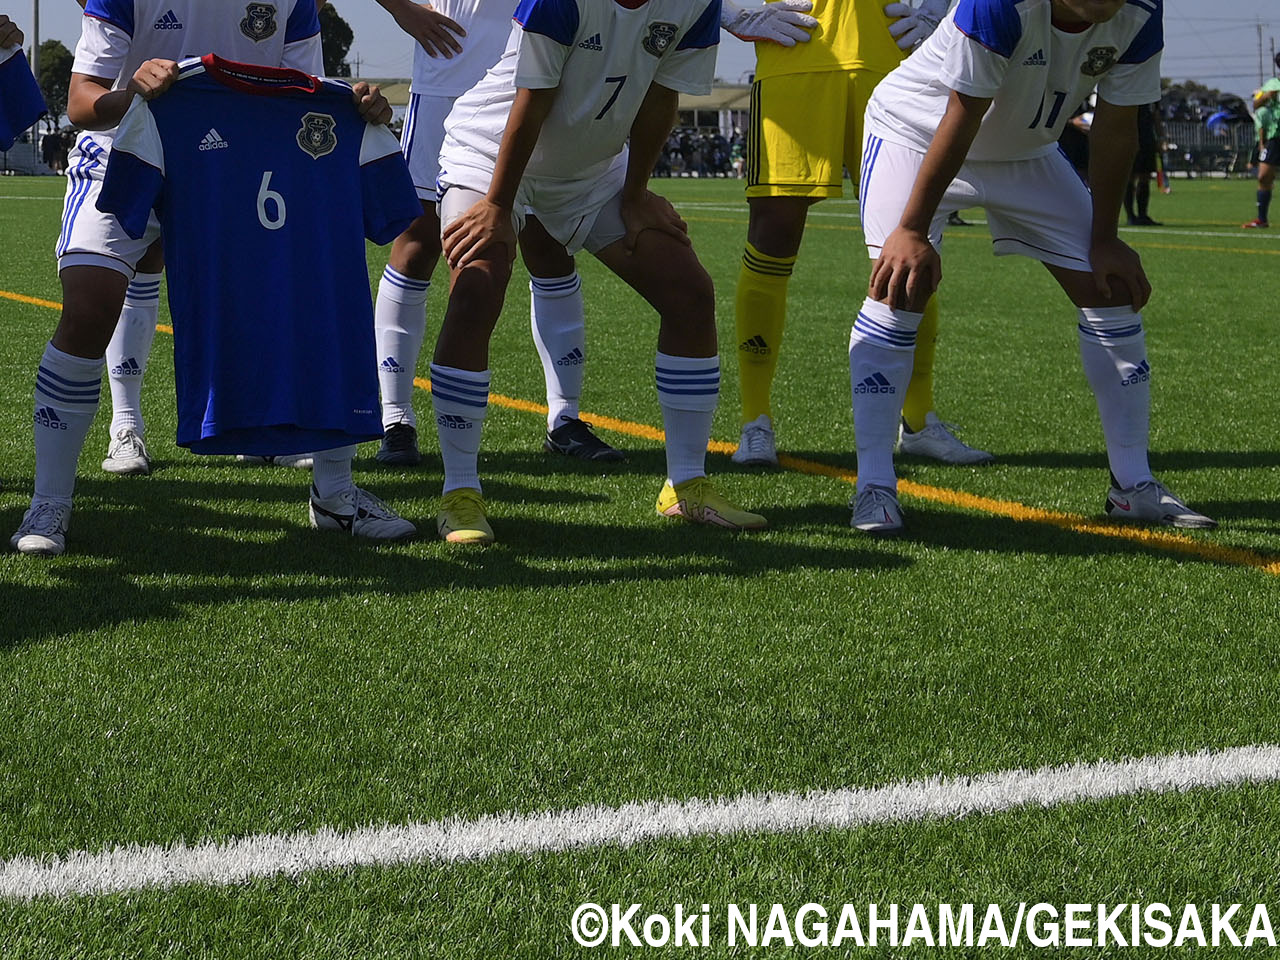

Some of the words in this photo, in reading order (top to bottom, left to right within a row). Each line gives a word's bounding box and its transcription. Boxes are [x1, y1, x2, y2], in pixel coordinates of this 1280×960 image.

[154, 22, 183, 30] adidas
[578, 42, 603, 51] adidas
[594, 75, 627, 121] 7
[1028, 88, 1067, 129] 11
[198, 141, 229, 151] adidas
[256, 171, 286, 230] 6
[112, 368, 142, 376] adidas
[854, 385, 896, 394] adidas
